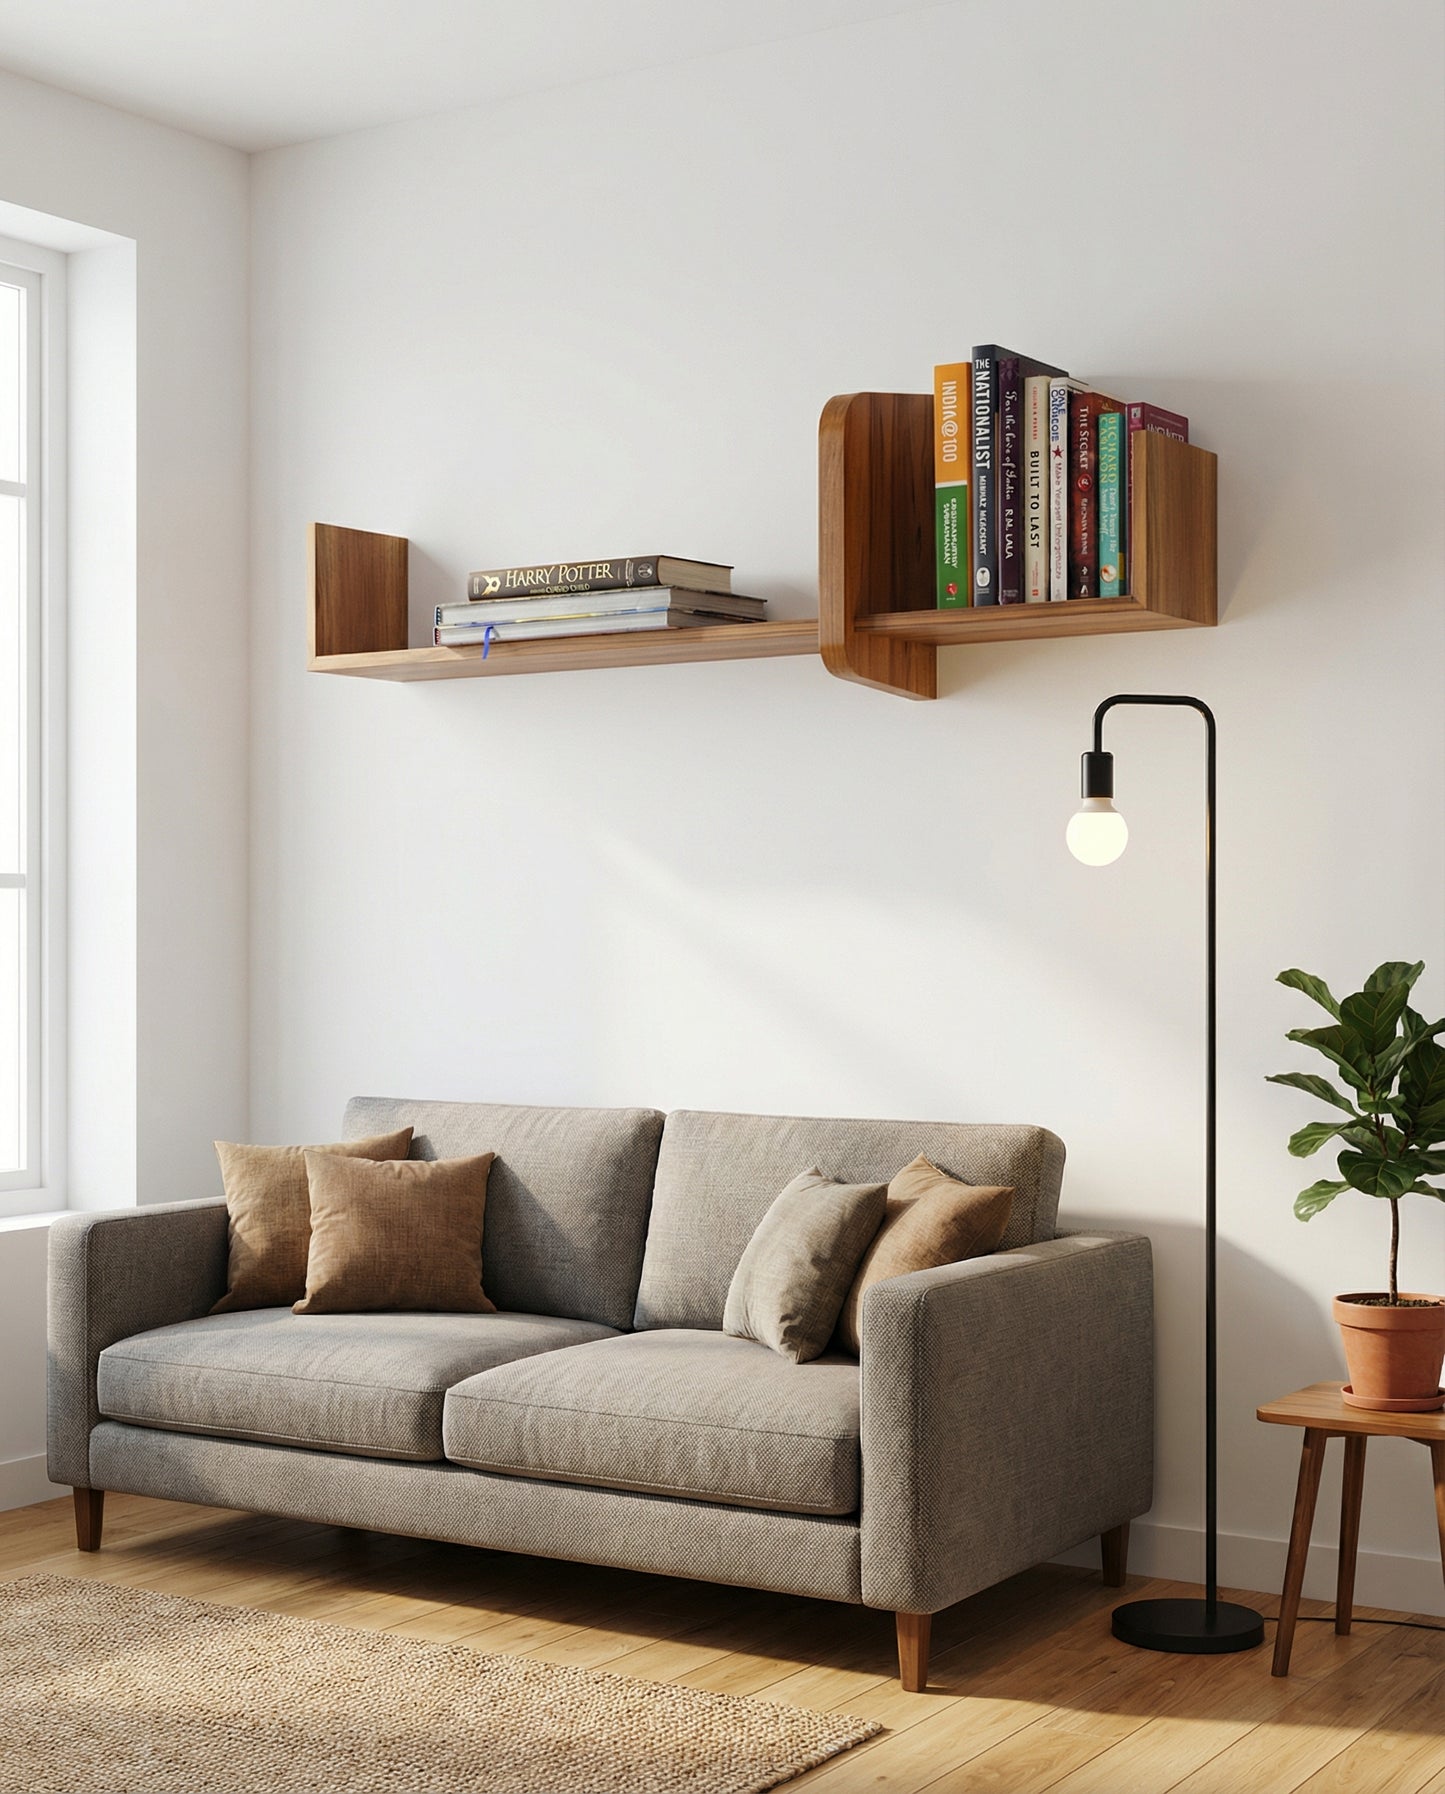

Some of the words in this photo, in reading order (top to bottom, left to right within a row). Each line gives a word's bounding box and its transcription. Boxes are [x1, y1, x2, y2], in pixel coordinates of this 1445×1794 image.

[975, 358, 990, 369] THE
[975, 371, 991, 469] NATIONALIST
[1005, 414, 1016, 431] the
[1080, 406, 1089, 428] THE
[1005, 432, 1016, 455] love
[1080, 430, 1089, 469] SECRET
[1108, 416, 1117, 483] RICHARD
[1002, 456, 1016, 469] of
[1030, 450, 1040, 488] BUILT
[1030, 494, 1040, 510] TO
[1030, 516, 1040, 548] LAST
[1005, 533, 1013, 560] LALA
[505, 566, 555, 588] HARRY
[557, 563, 614, 585] POTTER
